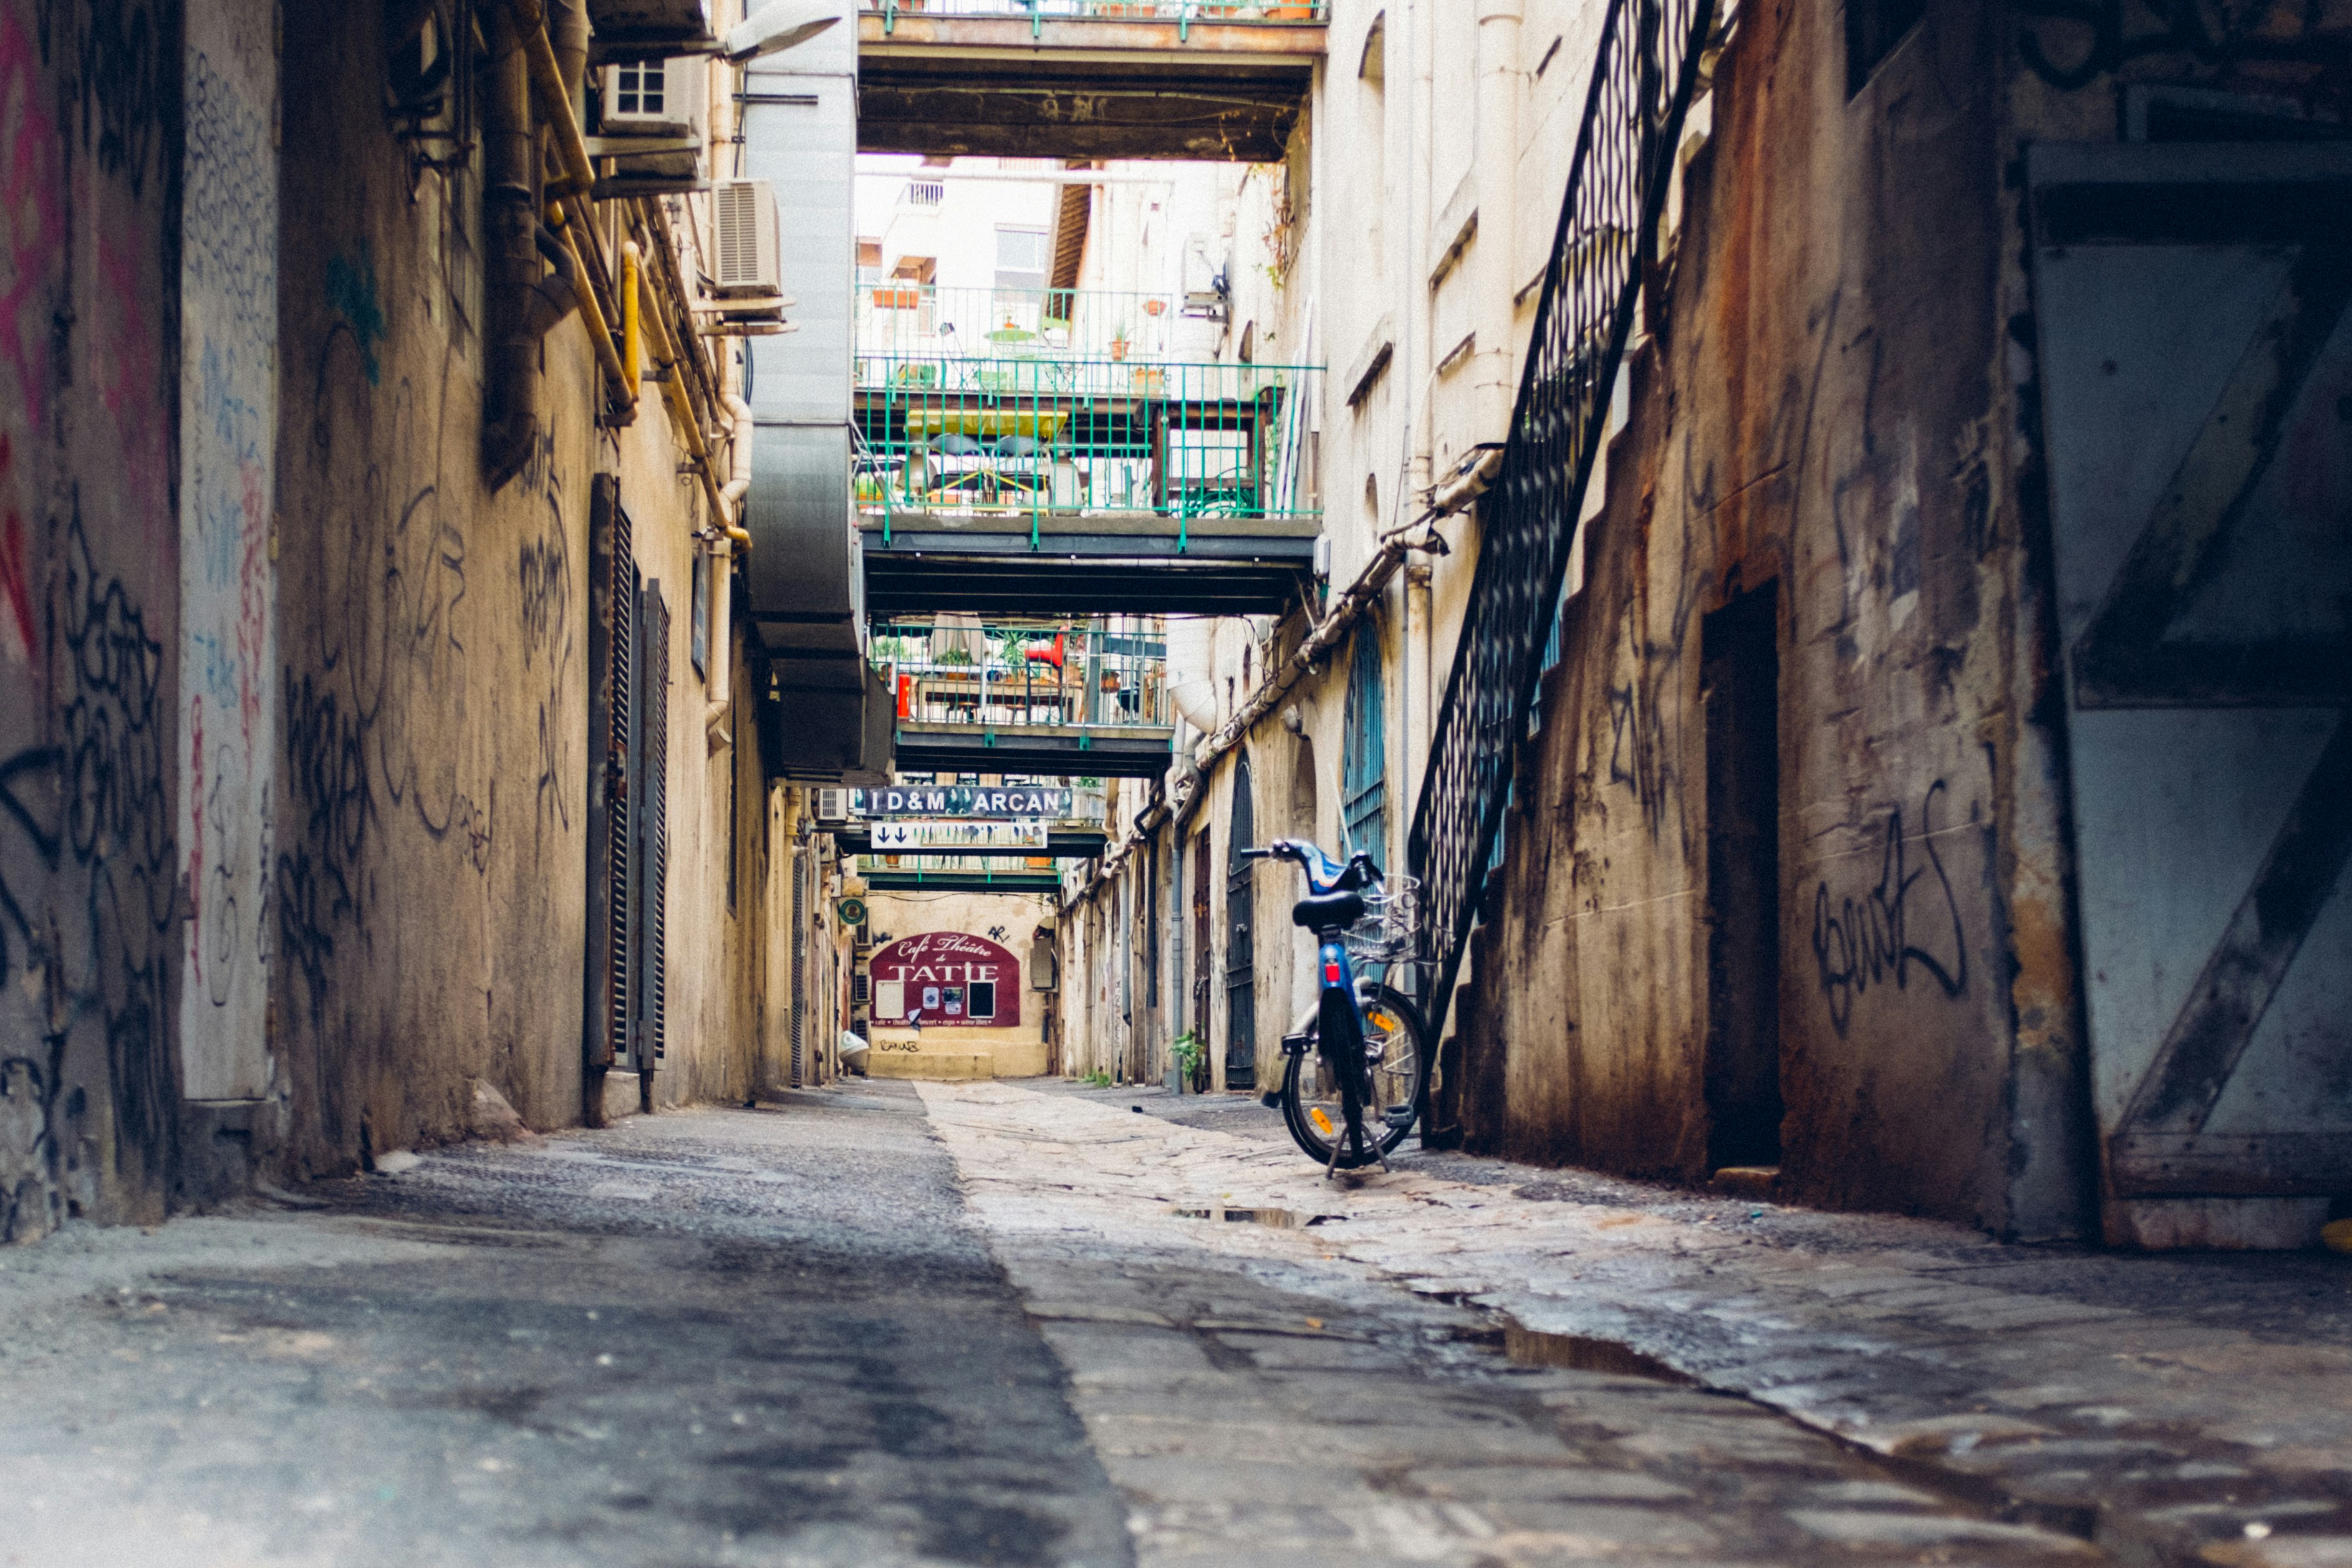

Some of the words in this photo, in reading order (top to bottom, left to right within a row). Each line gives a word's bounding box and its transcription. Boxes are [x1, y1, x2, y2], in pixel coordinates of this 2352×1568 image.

[973, 793, 1059, 812] ARCAN
[898, 935, 931, 963] Café
[932, 935, 991, 956] Théâtre
[935, 954, 946, 962] de
